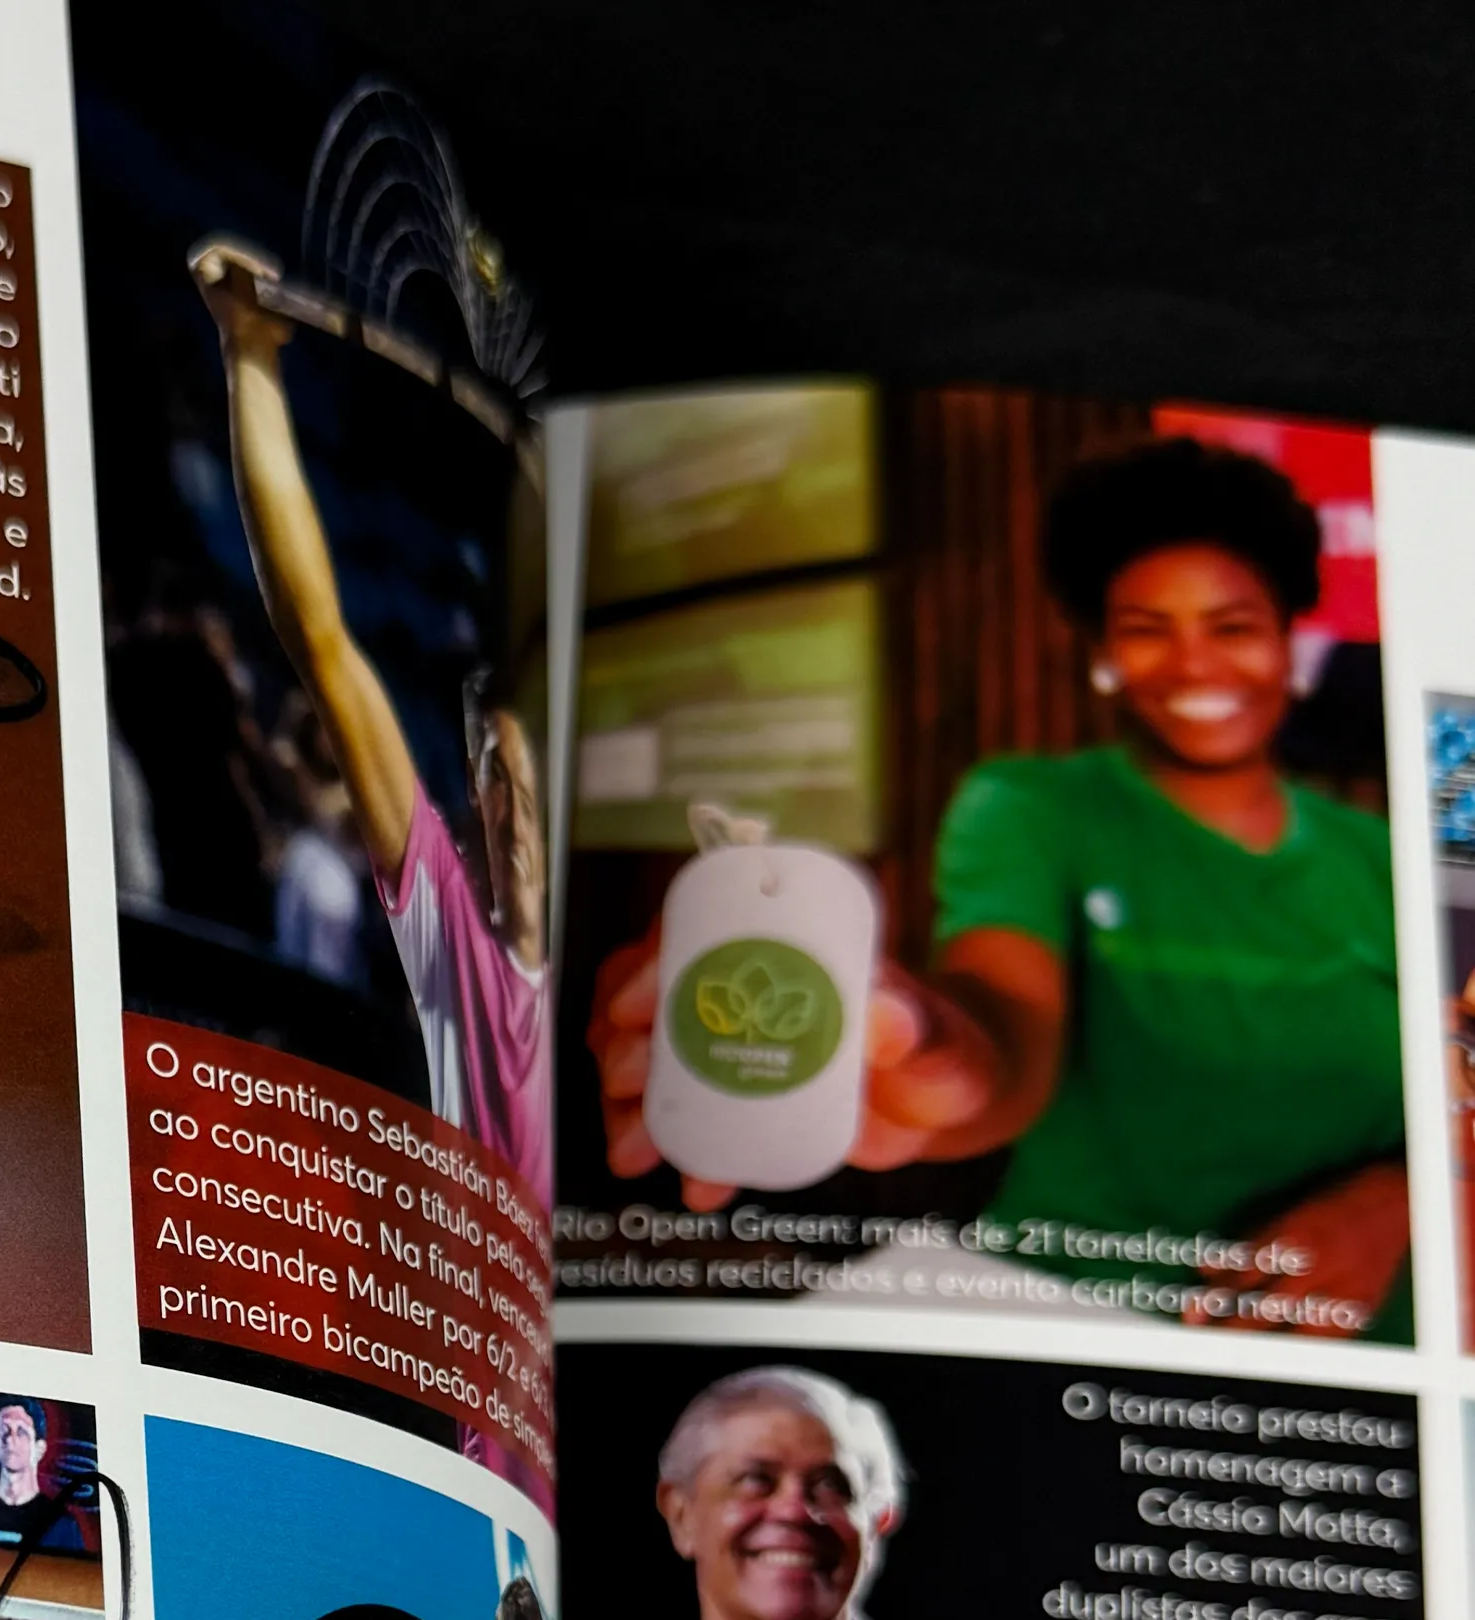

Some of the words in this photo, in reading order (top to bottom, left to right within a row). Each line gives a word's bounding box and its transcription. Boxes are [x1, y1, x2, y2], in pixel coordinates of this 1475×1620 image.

[5, 523, 27, 548] e
[146, 1042, 178, 1078] O
[193, 1062, 361, 1133] argentino
[367, 1108, 492, 1201] Sebastián
[496, 1179, 533, 1239] Báez
[149, 1108, 198, 1141] ao
[211, 1122, 388, 1198] conquistar
[395, 1184, 414, 1210] o
[421, 1188, 481, 1247] título
[486, 1231, 525, 1281] pela
[152, 1167, 370, 1250] consecutiva.
[380, 1222, 422, 1271] Na
[428, 1249, 484, 1307] final,
[553, 1206, 615, 1241] Rio
[618, 1203, 727, 1247] Open
[862, 1212, 957, 1248] mais
[959, 1213, 1016, 1252] de
[1017, 1218, 1063, 1256] 21
[1065, 1223, 1256, 1271] toneladas
[1256, 1237, 1316, 1276] de
[156, 1217, 337, 1293] Alexandre
[347, 1265, 436, 1331] Muller
[444, 1315, 481, 1357] por
[487, 1335, 518, 1379] 6/2
[707, 1252, 892, 1290] reciclados
[901, 1267, 928, 1295] e
[935, 1266, 1060, 1303] evento
[1072, 1271, 1237, 1317] carbono
[1239, 1290, 1376, 1331] neutro.
[159, 1284, 312, 1343] primeiro
[323, 1314, 480, 1410] bicampeão
[485, 1387, 511, 1429] de
[1062, 1382, 1109, 1420] O
[1110, 1387, 1257, 1434] torneio
[1259, 1405, 1413, 1449] prestou
[1121, 1435, 1376, 1496] homenagem
[1376, 1469, 1416, 1498] a
[1138, 1488, 1279, 1535] Cássio
[1280, 1500, 1416, 1554] Motta,
[1095, 1542, 1169, 1575] um
[1169, 1541, 1252, 1583] dos
[1252, 1555, 1419, 1600] maiores
